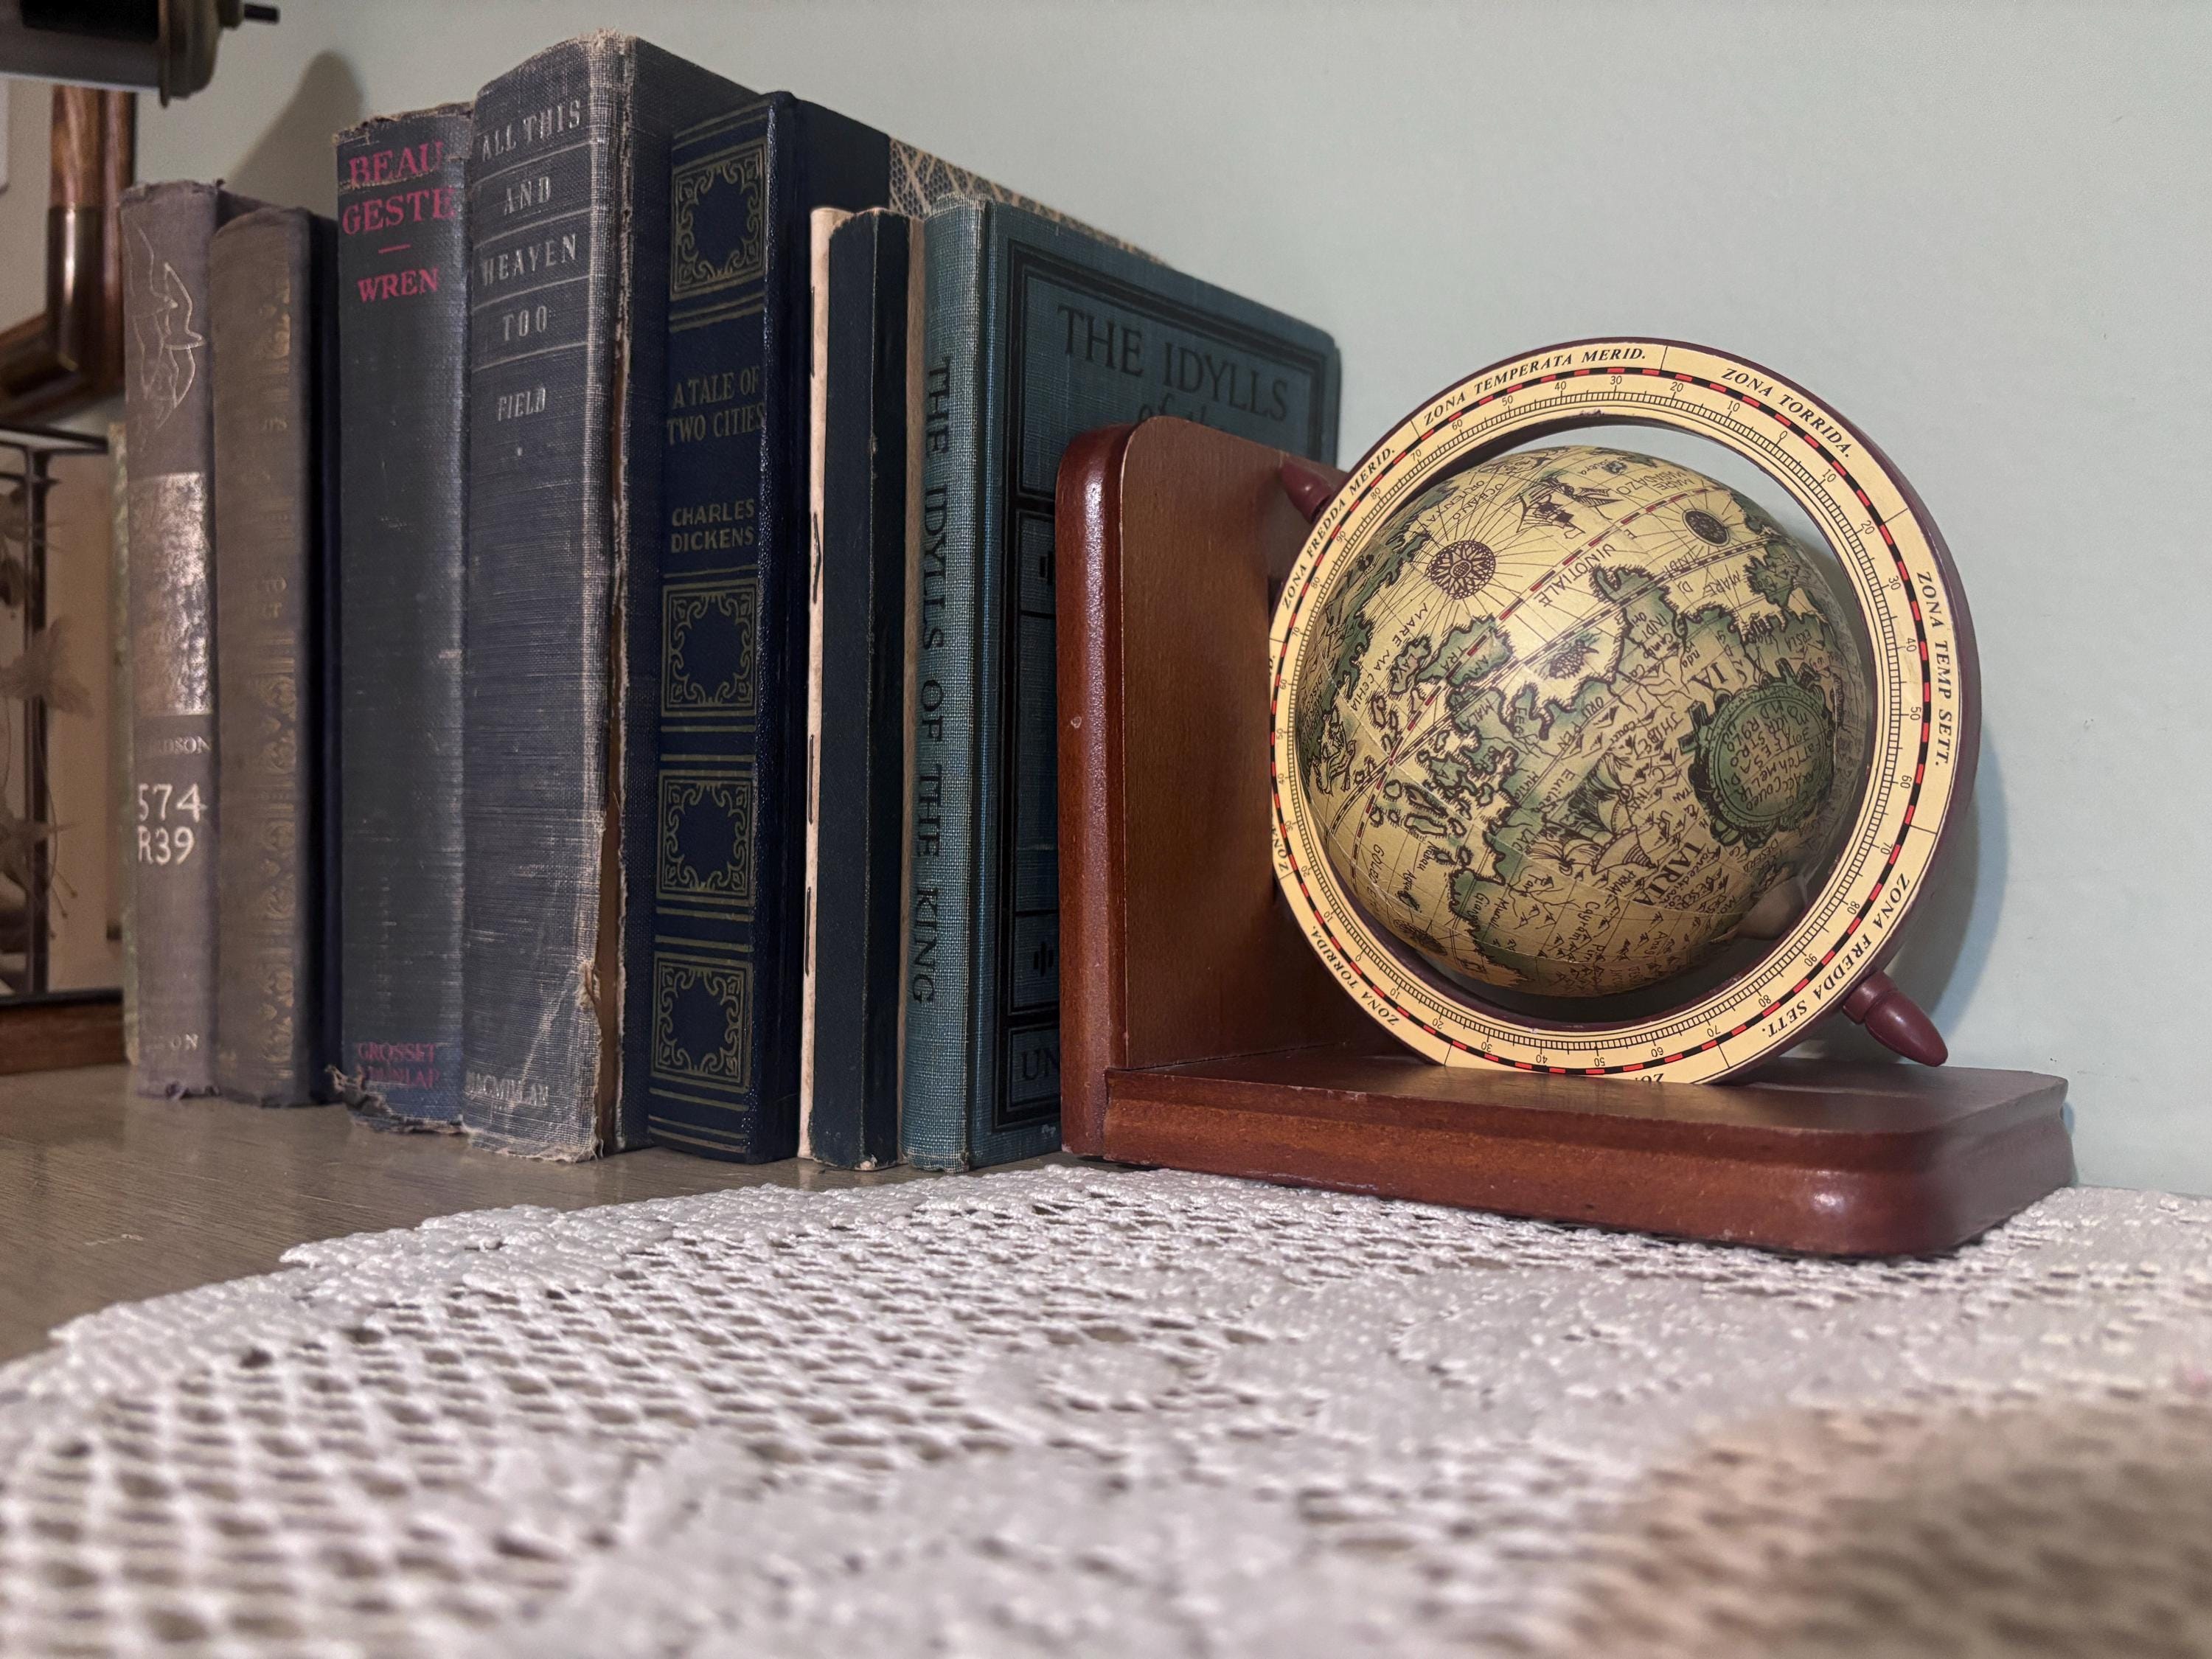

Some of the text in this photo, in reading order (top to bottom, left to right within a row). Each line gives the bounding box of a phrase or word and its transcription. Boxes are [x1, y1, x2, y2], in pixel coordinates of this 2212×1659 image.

[481, 100, 581, 162] ALL THIS
[348, 141, 445, 185] BEAU
[504, 176, 551, 216] AND
[342, 187, 457, 236] GESTE
[481, 233, 577, 287] HEAVEN
[357, 268, 440, 304] WREN
[503, 305, 548, 341] TOO
[1057, 305, 1288, 421] THE IDYLLS
[686, 372, 734, 406] TALE
[740, 366, 760, 396] OF
[1424, 347, 1647, 426] ZONA TEMPERATA MERID.
[1554, 380, 1567, 392] 40
[1610, 375, 1622, 386] 30
[1669, 381, 1684, 393] 20
[498, 387, 546, 422] FIELD
[1501, 394, 1514, 406] 50
[1728, 400, 1741, 413] 10
[1719, 368, 1853, 459] ZONA TORRIDA.
[666, 401, 767, 446] TWO CITIES
[1451, 419, 1464, 431] 60
[1411, 448, 1422, 462] 70
[1824, 468, 1837, 484] 10
[1370, 487, 1381, 501] 80
[672, 498, 756, 527] CHARLES
[1282, 448, 1396, 611] ZONA FREDDA MERID.
[1860, 520, 1876, 535] 20
[671, 526, 755, 554] DICKENS
[1335, 531, 1346, 543] 90
[1310, 577, 1321, 590] 80
[1888, 575, 1902, 591] 30
[1291, 626, 1301, 637] 70
[1389, 602, 1429, 647] MARE
[1905, 637, 1918, 653] 40
[1916, 571, 1953, 767] ZONA TEMP SETT.
[912, 358, 952, 1005] THE IDYLLS OF THE KING
[1279, 678, 1287, 691] 60
[1910, 706, 1922, 721] 50
[1276, 727, 1284, 740] 50
[1278, 773, 1285, 785] 40
[1899, 774, 1913, 789] 60
[137, 783, 208, 823] 574
[1285, 819, 1293, 832] 30
[137, 825, 195, 866] R39
[1879, 841, 1893, 855] 70
[1301, 865, 1310, 877] 20
[1846, 900, 1861, 915] 80
[1323, 910, 1335, 923] 10
[1761, 872, 1911, 1038] ZONA FREDDA SETT.
[1804, 953, 1818, 968] 90
[1310, 925, 1401, 1026] ZONA TORRIDA.
[1389, 987, 1401, 1000] 10
[1758, 995, 1772, 1009] 80
[1431, 1018, 1444, 1030] 20
[1706, 1023, 1722, 1038] 70
[1481, 1040, 1493, 1053] 30
[1650, 1046, 1665, 1058] 60
[1535, 1053, 1548, 1065] 40
[1593, 1056, 1606, 1068] 50
